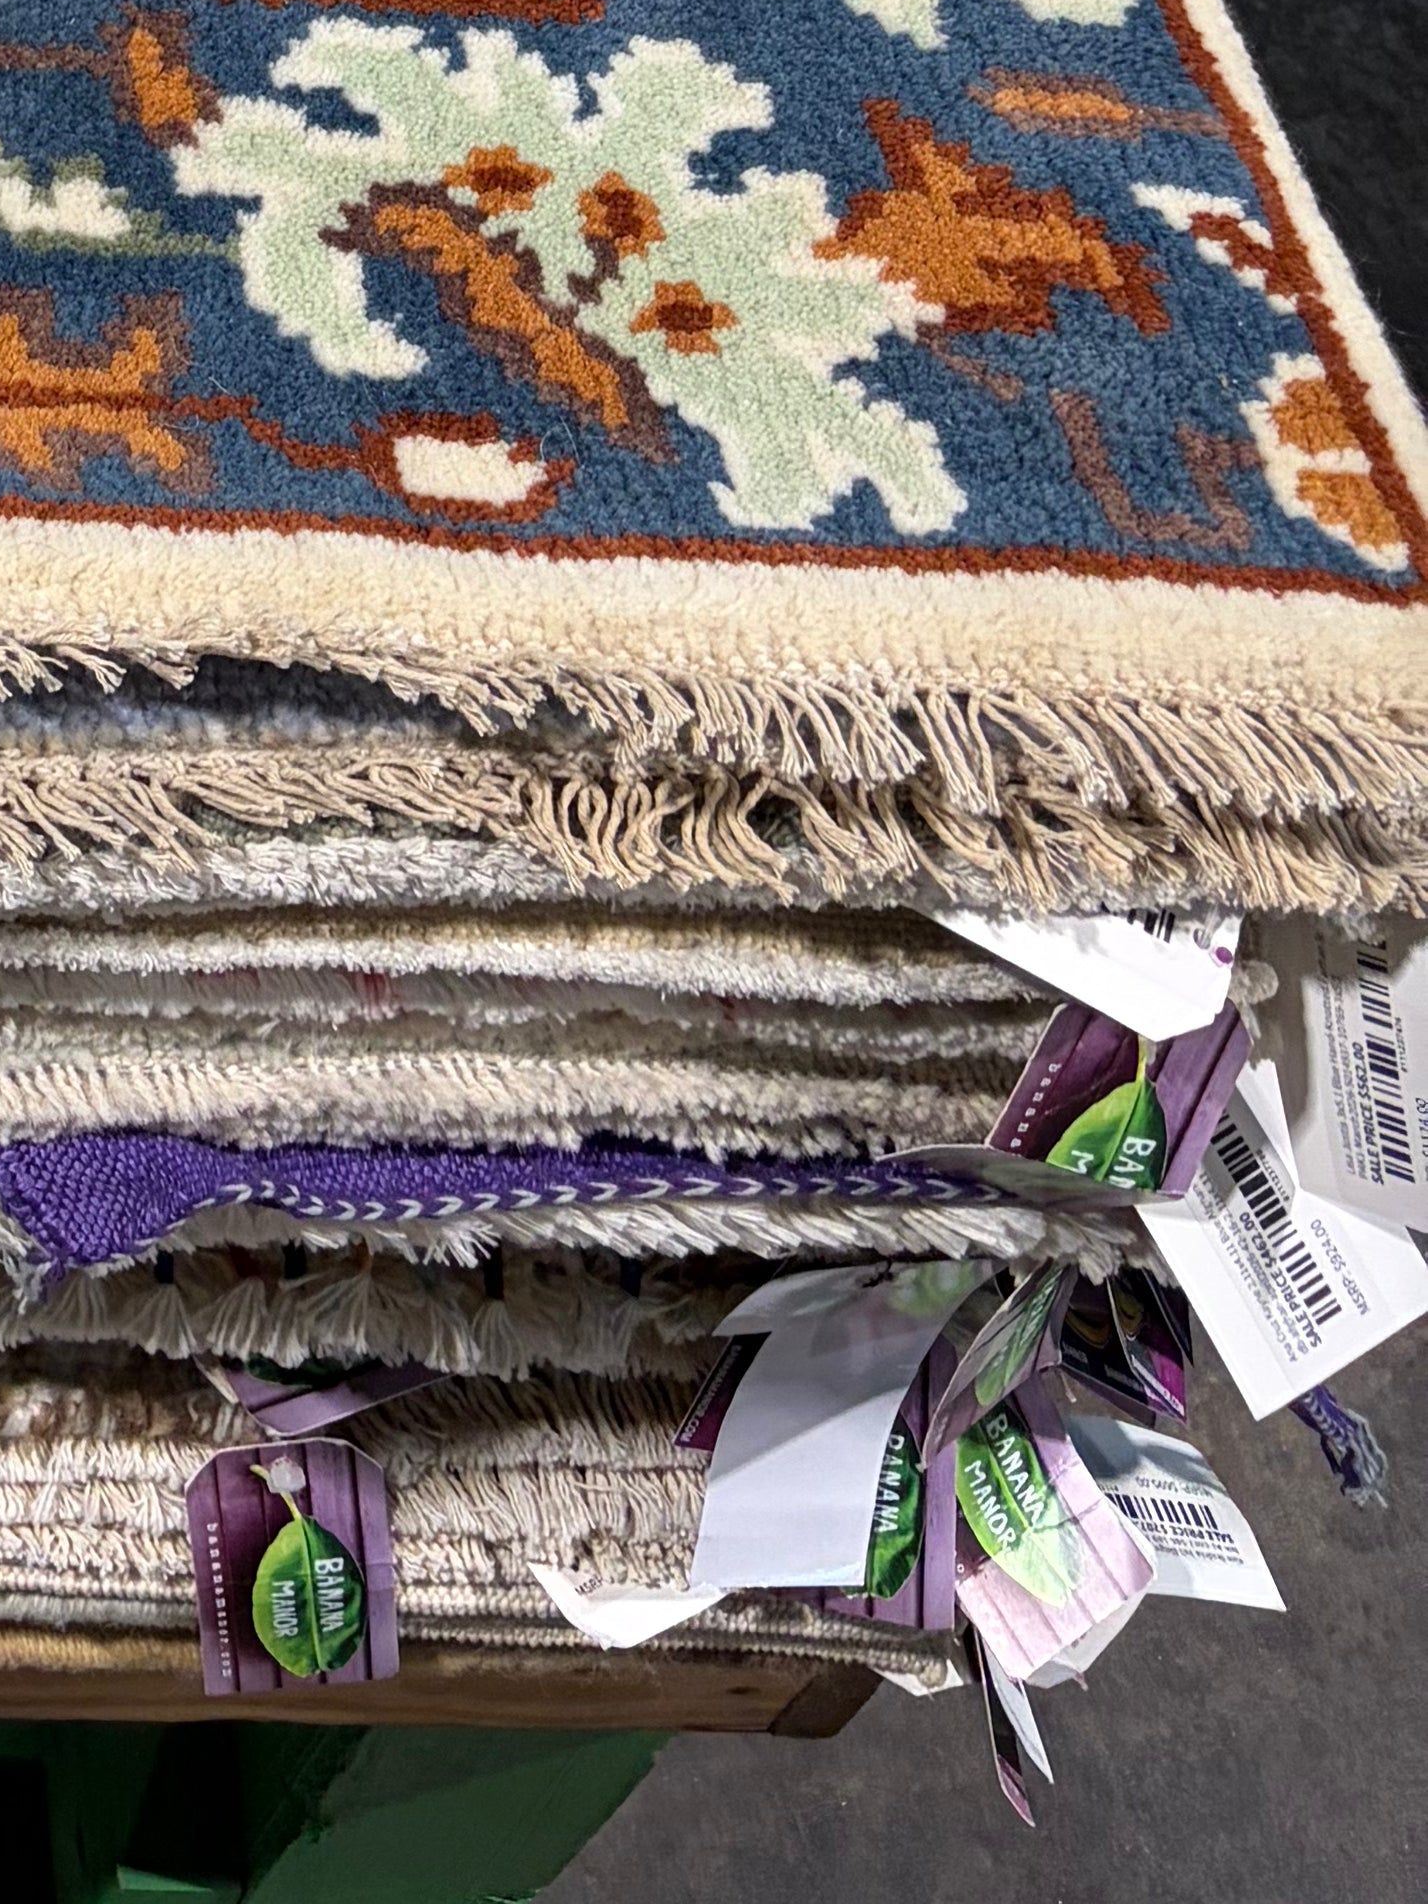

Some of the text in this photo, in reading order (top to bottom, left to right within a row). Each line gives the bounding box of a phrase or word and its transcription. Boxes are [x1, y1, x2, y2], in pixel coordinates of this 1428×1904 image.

[1350, 1040, 1384, 1185] SALE PRICE $562.00
[1237, 1209, 1323, 1349] SALE PRICE $462.00
[964, 1460, 1018, 1553] MANOR
[984, 1413, 1049, 1524] BANANA
[272, 1580, 299, 1638] MANOR
[314, 1557, 344, 1632] BANANA
